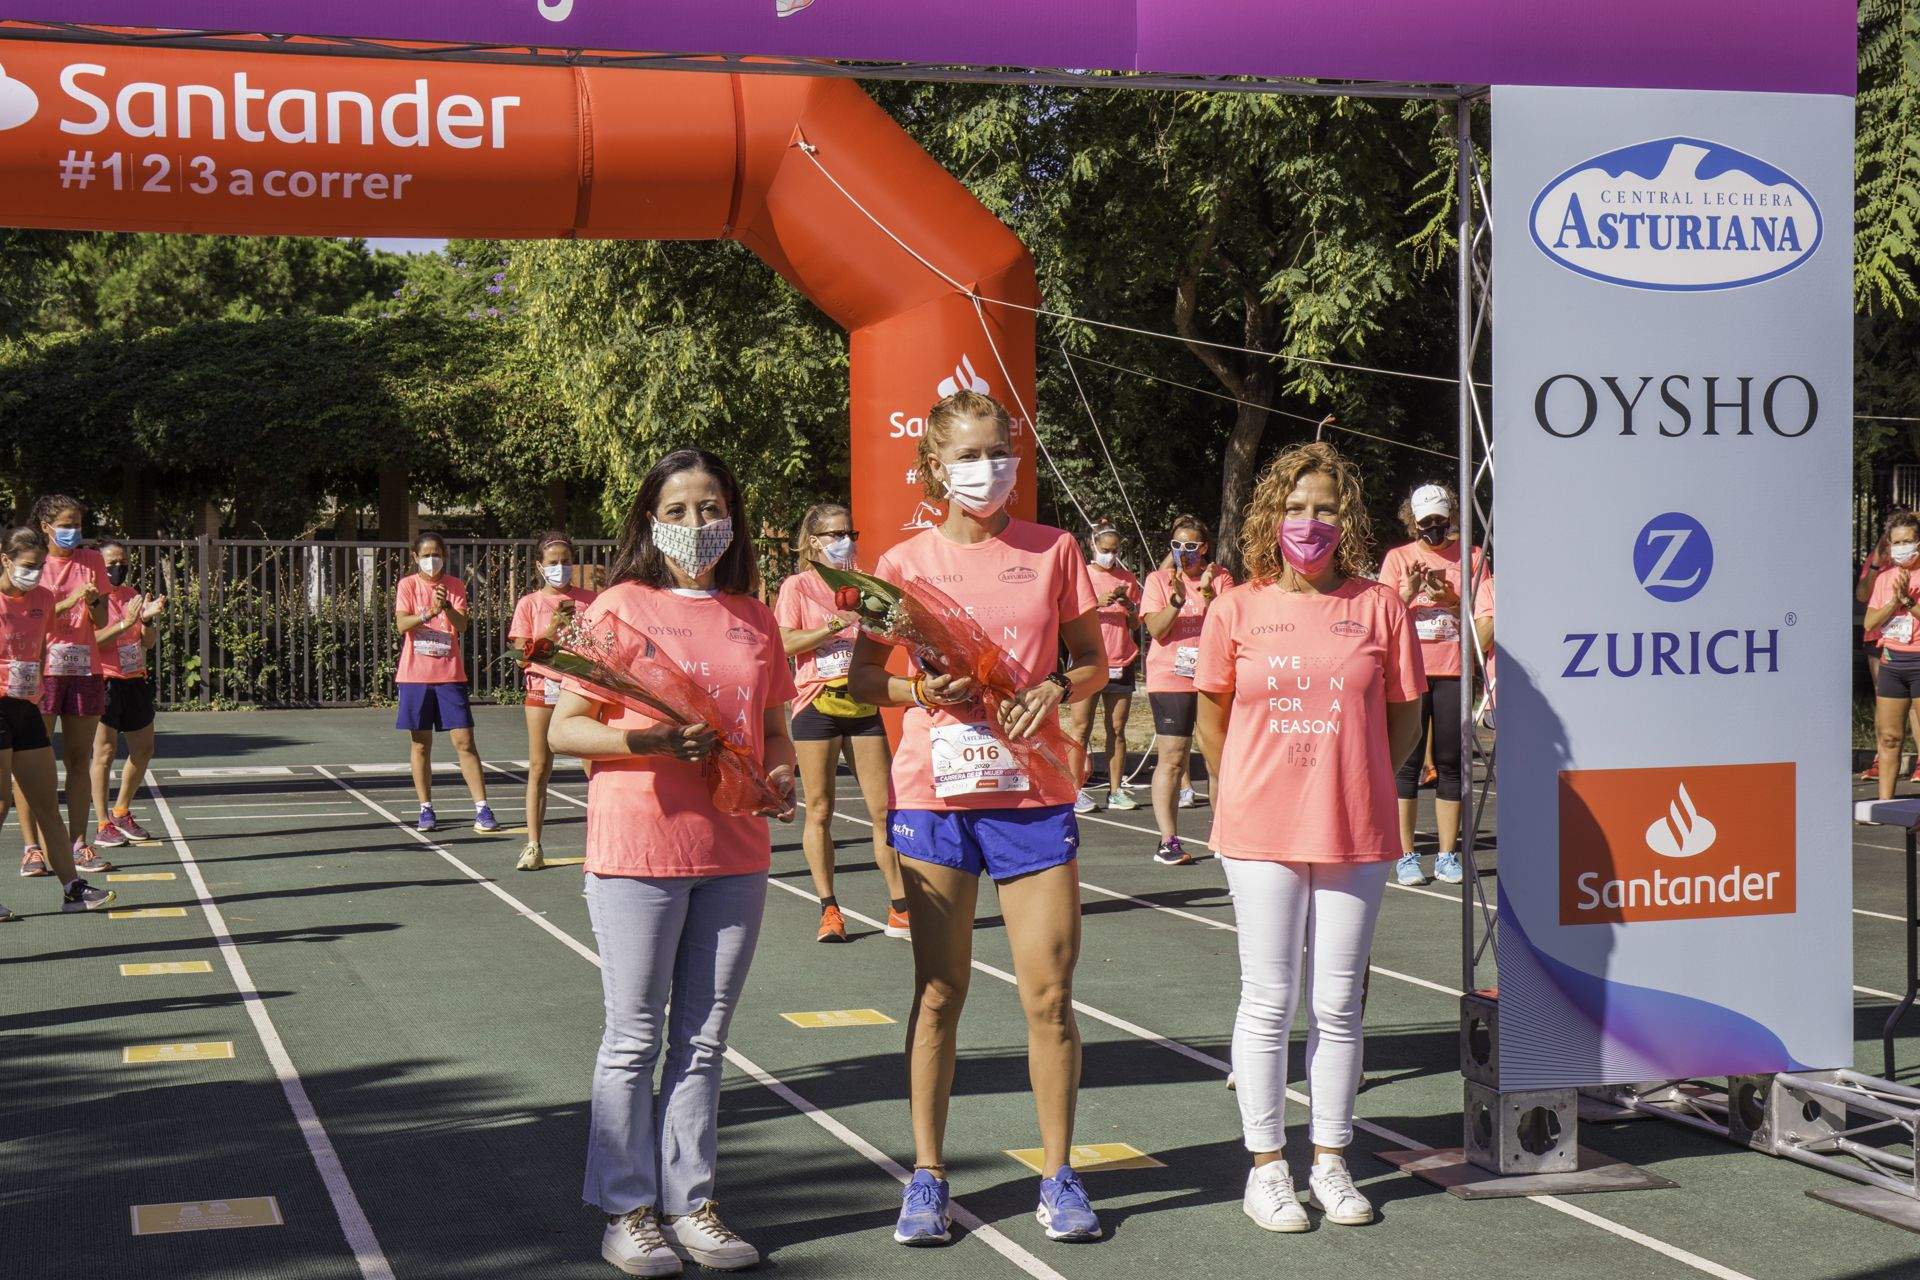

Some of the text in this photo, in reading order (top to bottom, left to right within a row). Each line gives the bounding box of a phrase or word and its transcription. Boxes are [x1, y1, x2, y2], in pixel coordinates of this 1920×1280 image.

[59, 62, 521, 149] Santander
[262, 166, 412, 200] correr
[1600, 189, 1794, 207] CENTRAL LECHERA
[1552, 191, 1804, 253] ASTURIANA
[1533, 373, 1819, 439] OYSHO
[1250, 623, 1296, 636] OYSHO
[1430, 618, 1448, 626] 016
[647, 625, 693, 638] OYSHO
[832, 651, 853, 660] 016
[1268, 655, 1301, 669] WE
[678, 660, 711, 677] WE
[1269, 697, 1342, 712] FOR A
[1269, 719, 1340, 734] REASON
[962, 745, 1000, 762] 016
[1576, 864, 1781, 911] Santander
